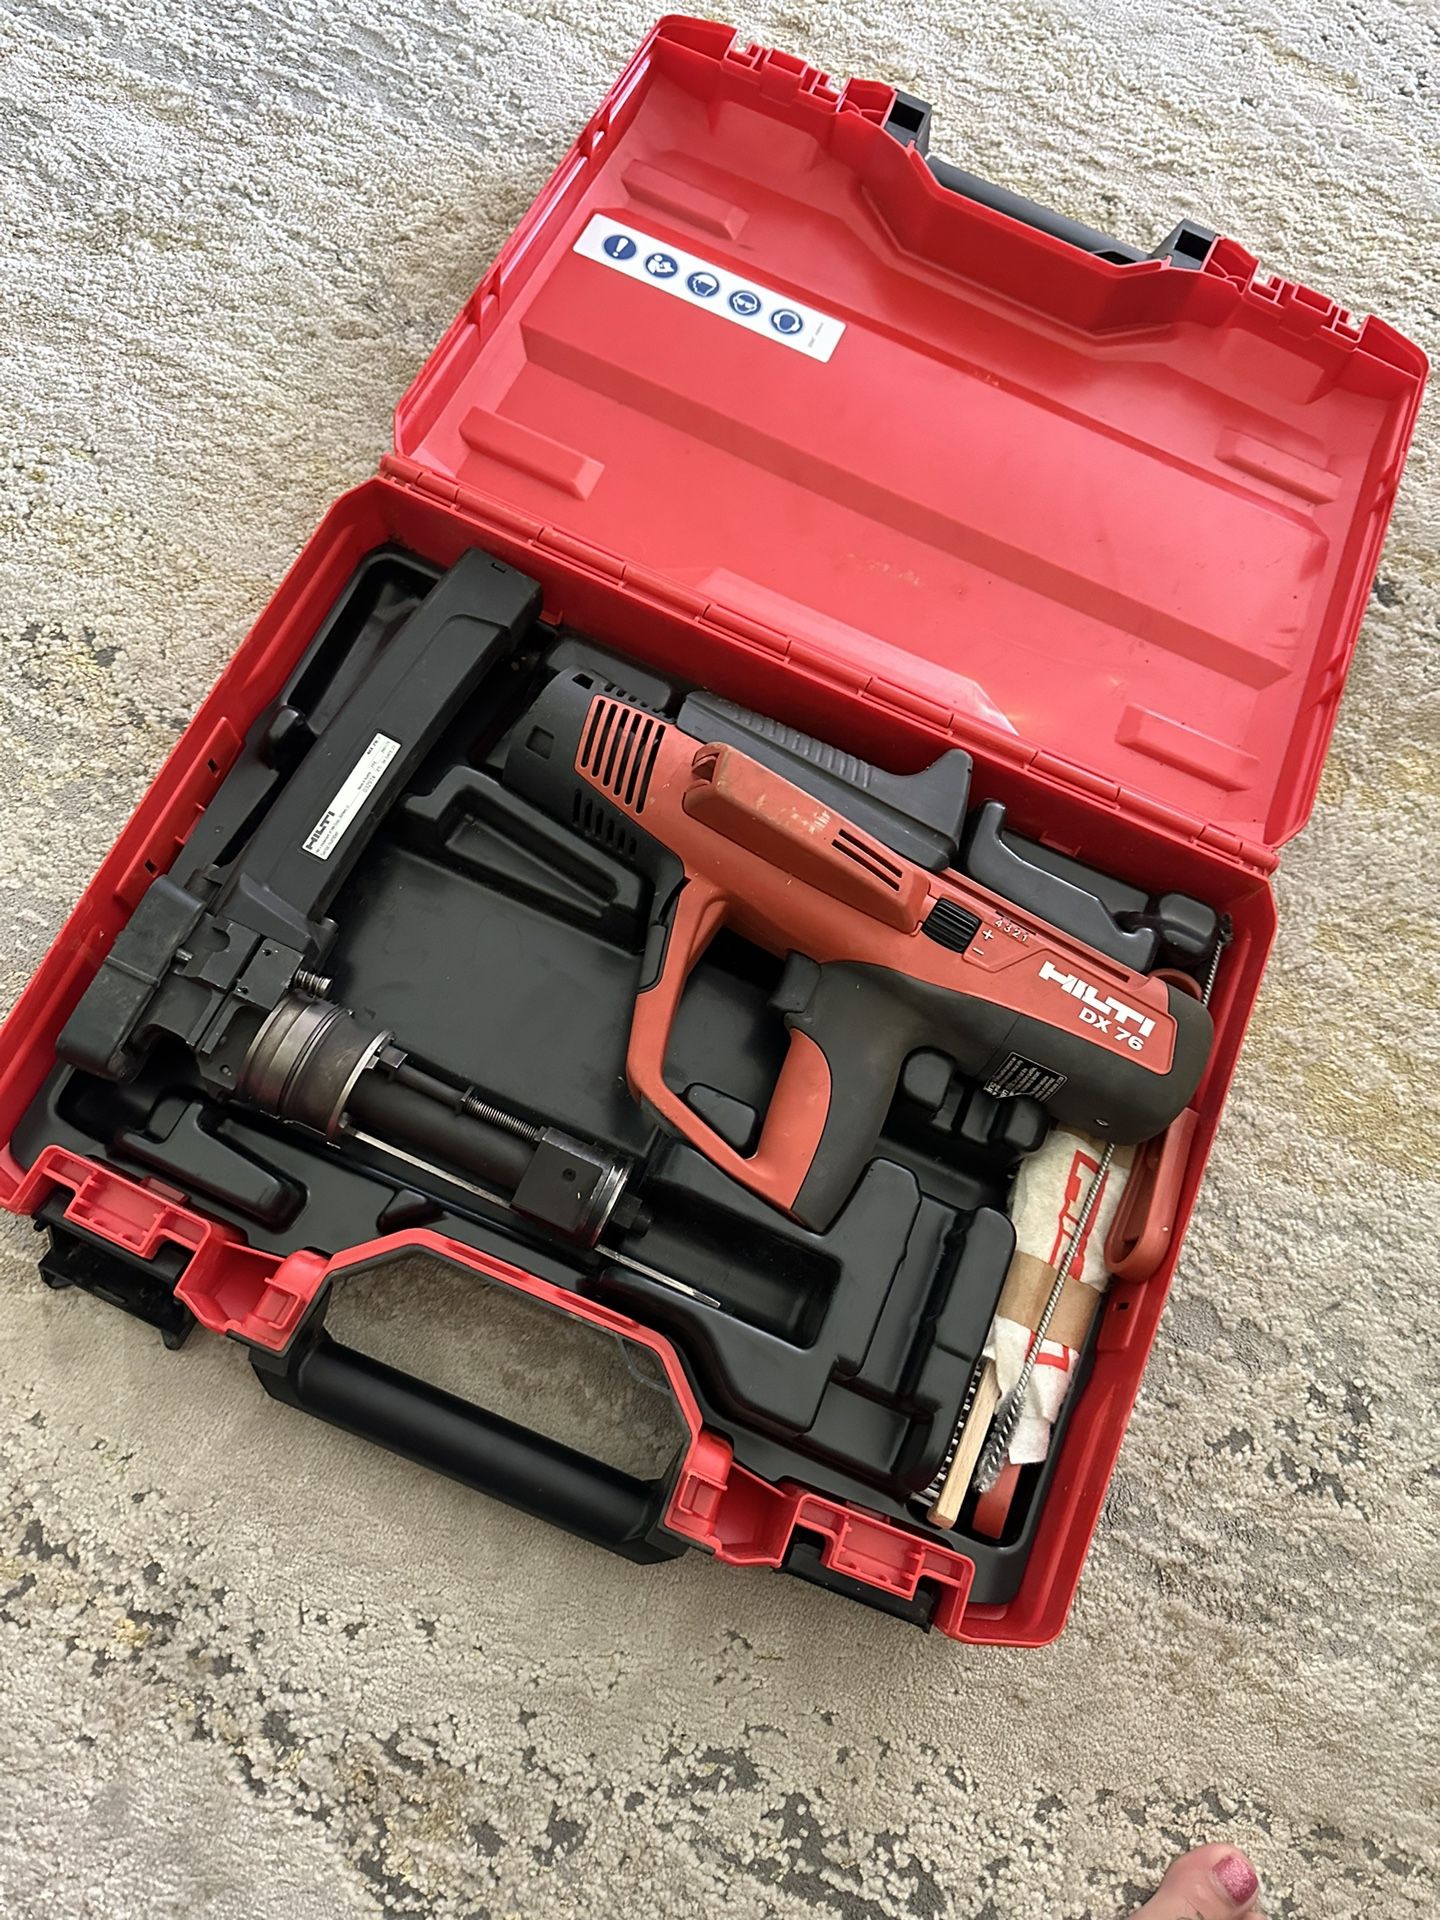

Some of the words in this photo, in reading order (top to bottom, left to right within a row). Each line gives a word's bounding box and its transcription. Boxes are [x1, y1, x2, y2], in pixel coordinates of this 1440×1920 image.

[305, 810, 335, 850] HILTI
[1038, 960, 1157, 1038] HILTI
[1078, 1006, 1113, 1034] DX
[1114, 1026, 1145, 1051] 76
